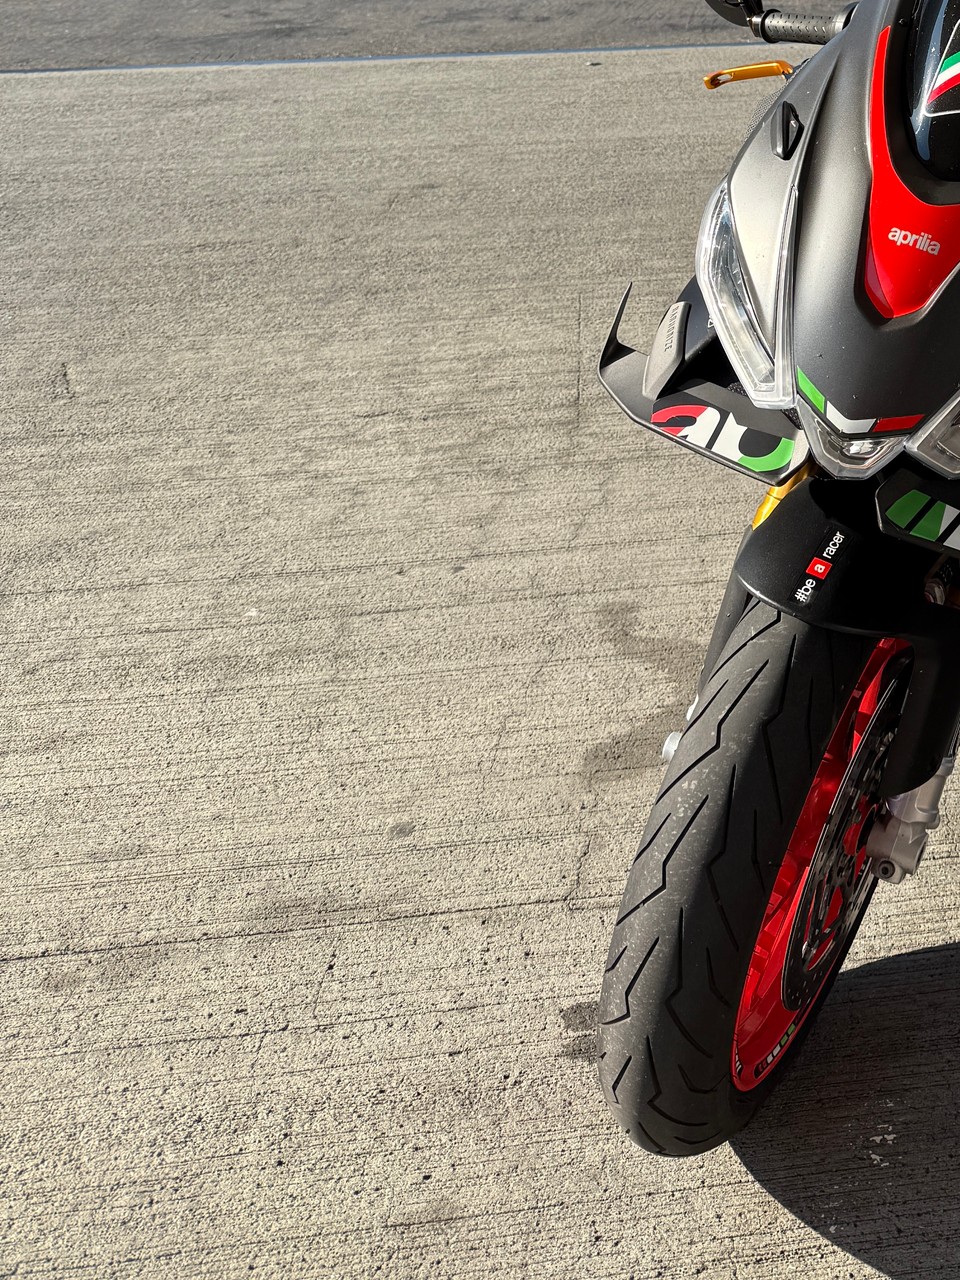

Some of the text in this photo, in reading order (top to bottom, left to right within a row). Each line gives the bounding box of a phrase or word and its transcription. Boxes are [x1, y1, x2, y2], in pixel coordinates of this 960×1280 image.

[888, 227, 941, 256] aprilia
[795, 531, 845, 602] #be a racer
